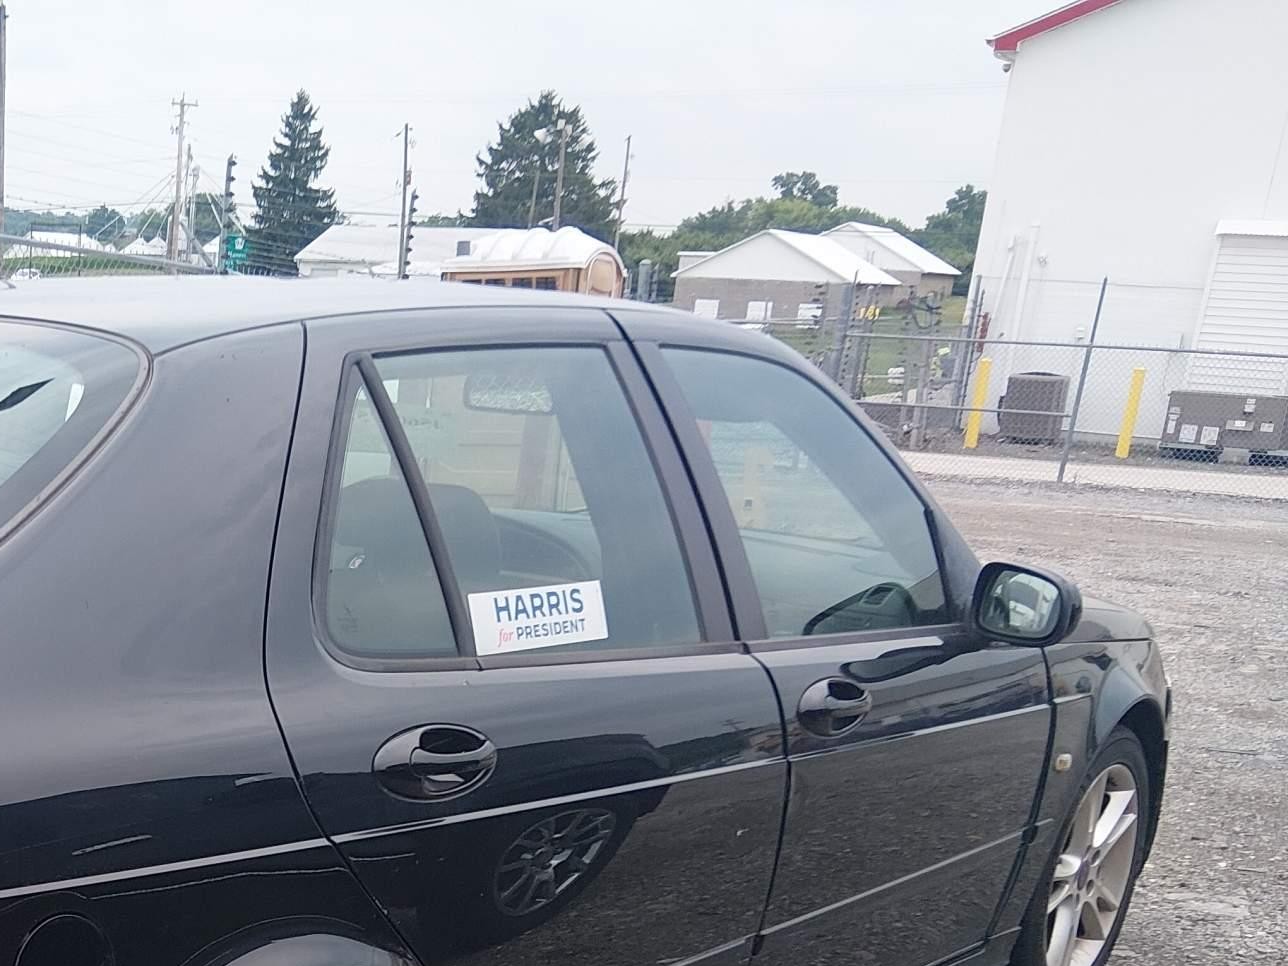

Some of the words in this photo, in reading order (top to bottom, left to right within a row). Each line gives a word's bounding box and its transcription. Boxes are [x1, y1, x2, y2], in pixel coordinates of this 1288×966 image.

[493, 588, 584, 622] HARRIS
[497, 628, 514, 648] for
[516, 618, 586, 641] PRESIDENT
